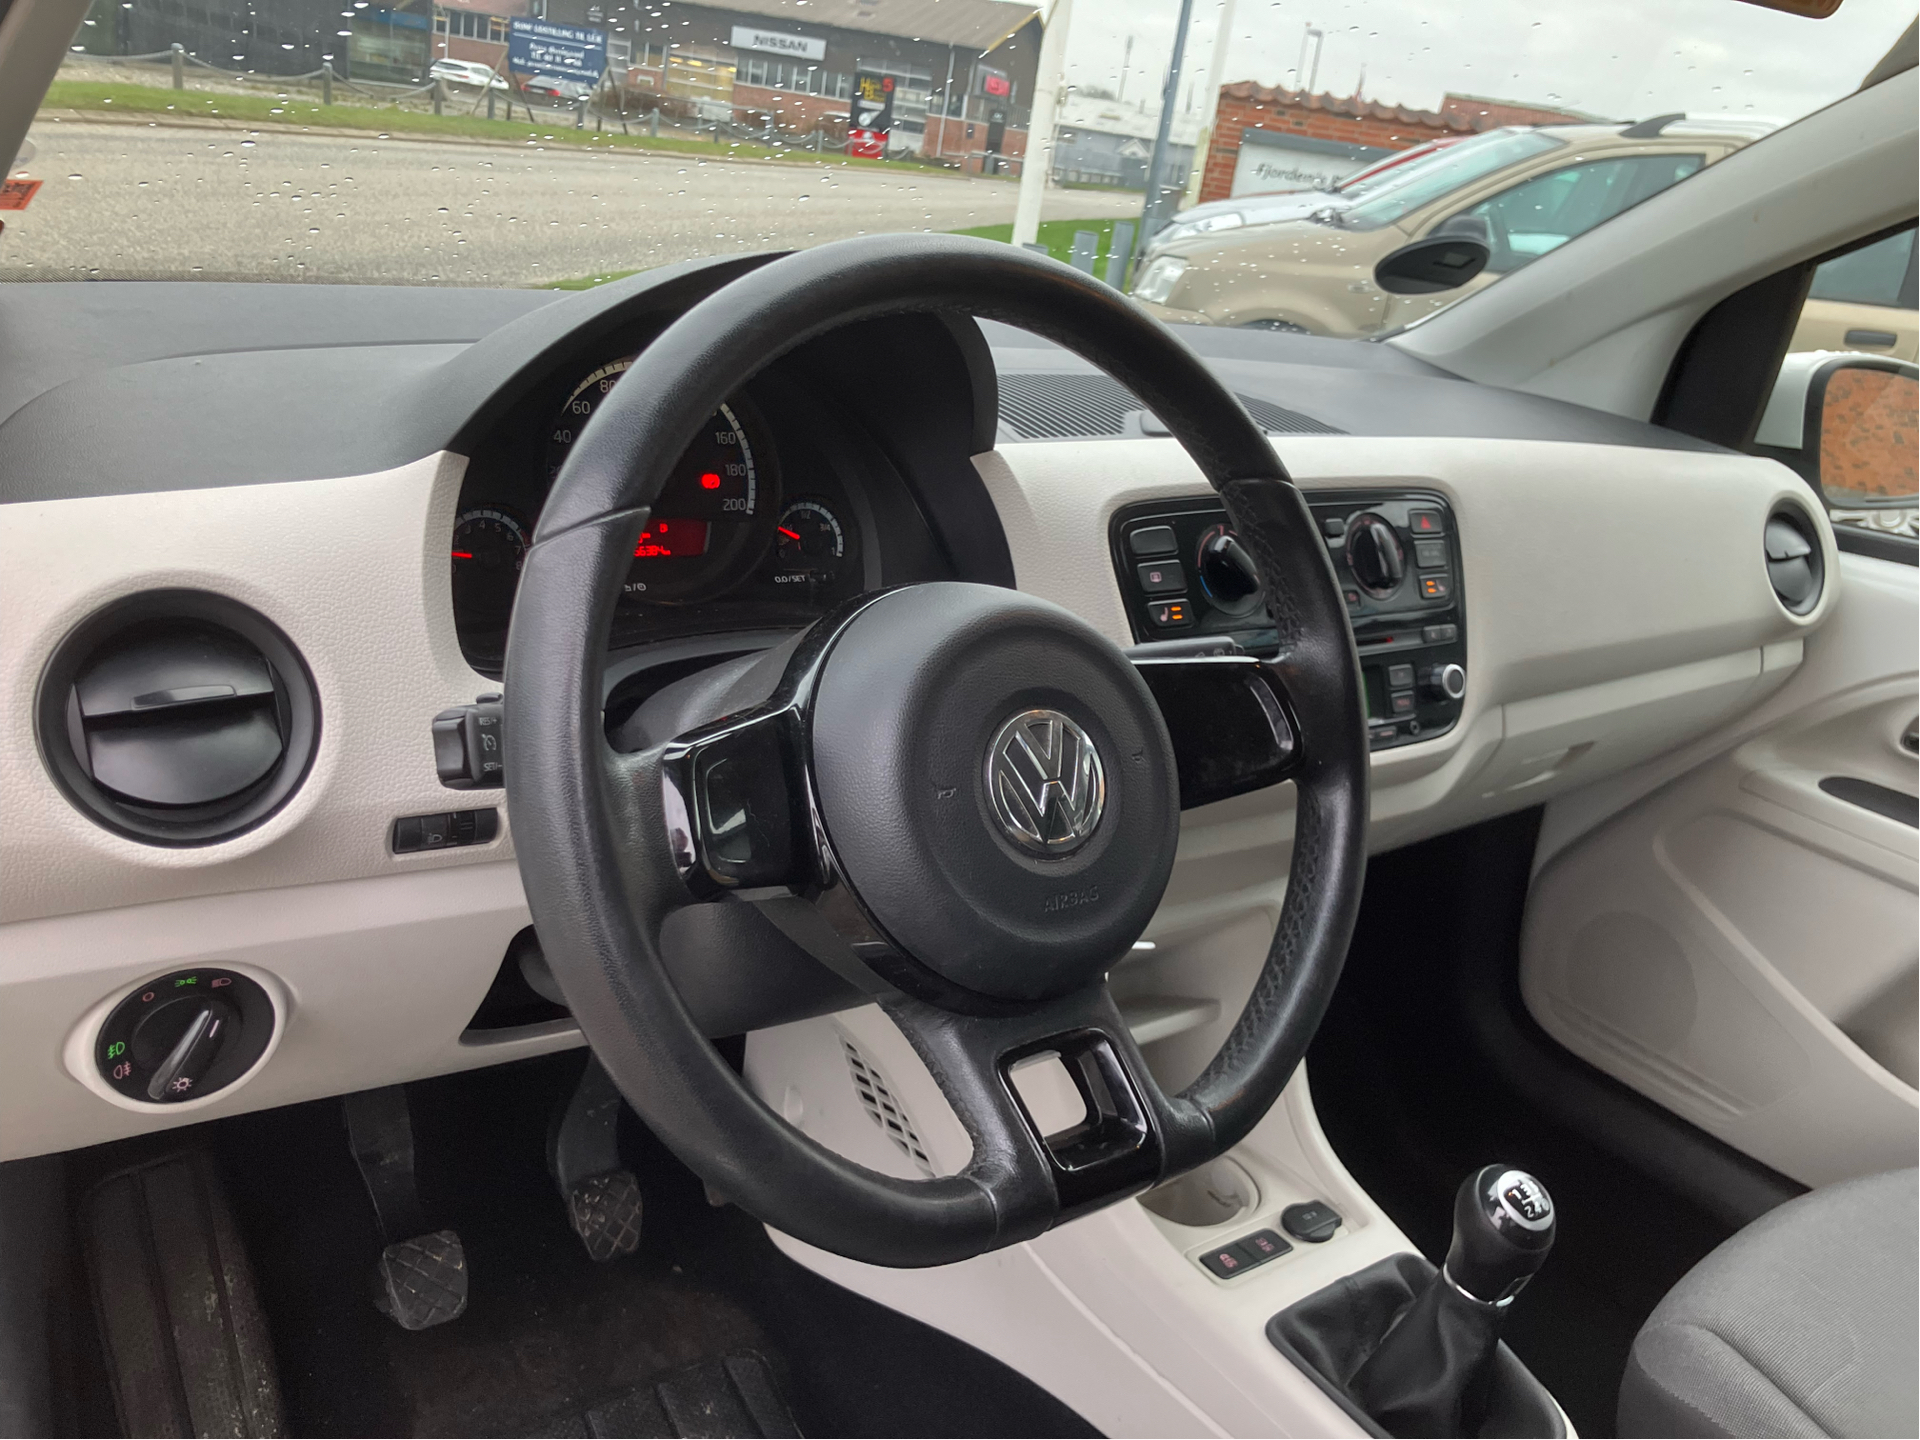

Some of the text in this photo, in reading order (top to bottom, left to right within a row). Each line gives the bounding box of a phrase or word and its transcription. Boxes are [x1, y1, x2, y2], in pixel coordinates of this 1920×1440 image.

[753, 34, 808, 53] NISSAN
[572, 400, 591, 415] 60
[553, 429, 572, 444] 40
[715, 431, 736, 445] 160
[725, 463, 747, 477] 180
[723, 498, 746, 512] 200
[479, 518, 487, 530] 4
[494, 522, 502, 533] 5
[506, 532, 515, 542] 6
[514, 545, 522, 556] 7
[1044, 885, 1100, 913] AIRBAG
[1511, 1188, 1522, 1200] 1
[1523, 1205, 1535, 1219] 2
